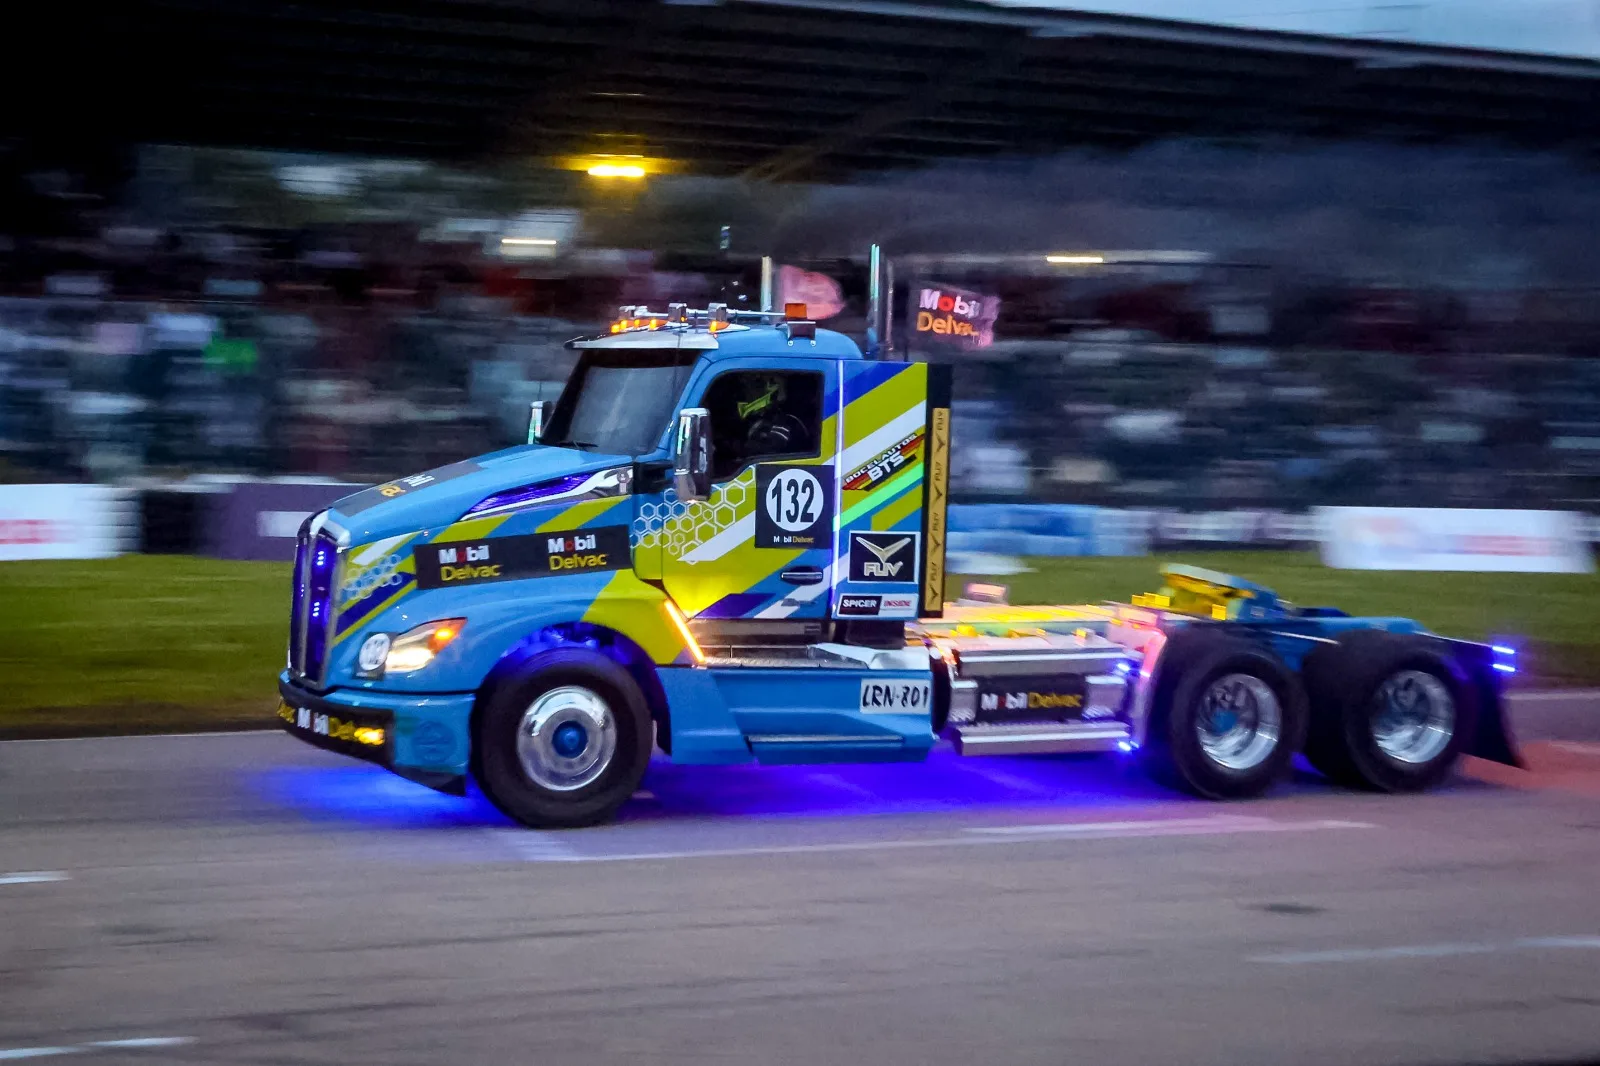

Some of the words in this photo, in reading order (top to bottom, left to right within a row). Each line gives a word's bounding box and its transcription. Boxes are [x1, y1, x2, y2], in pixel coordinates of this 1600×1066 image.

[867, 450, 905, 482] BTS
[771, 478, 815, 523] 132
[547, 534, 597, 553] Mobil
[438, 545, 490, 564] Mobil
[549, 553, 608, 571] Delvac
[440, 564, 503, 582] Delvac
[842, 599, 878, 608] SPICER
[883, 599, 912, 607] INSIDE
